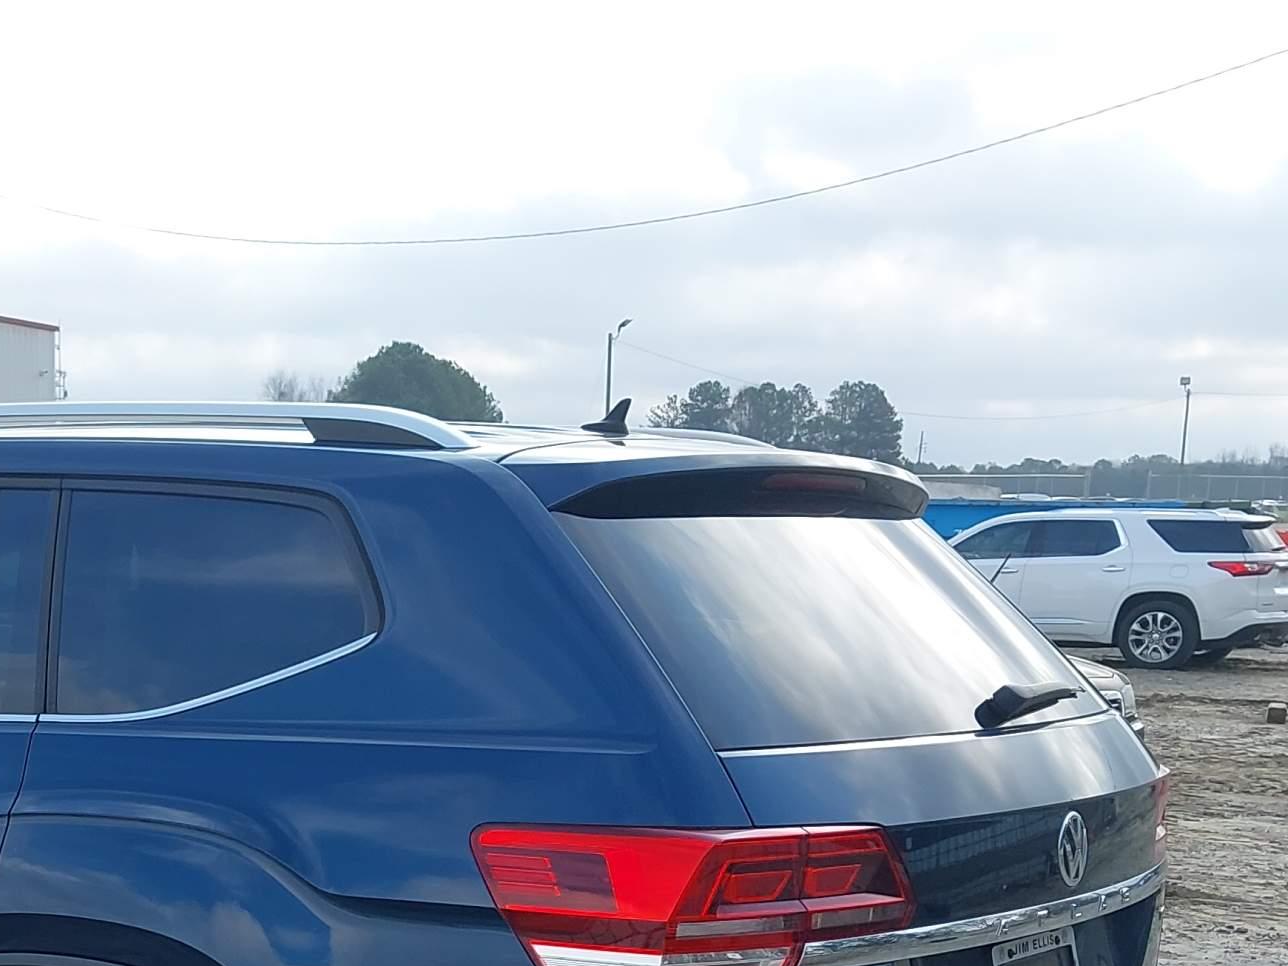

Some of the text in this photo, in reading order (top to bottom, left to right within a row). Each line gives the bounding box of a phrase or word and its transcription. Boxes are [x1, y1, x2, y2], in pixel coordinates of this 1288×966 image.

[995, 886, 1131, 937] ATLAS
[1012, 934, 1055, 956] JIM ELLIS
